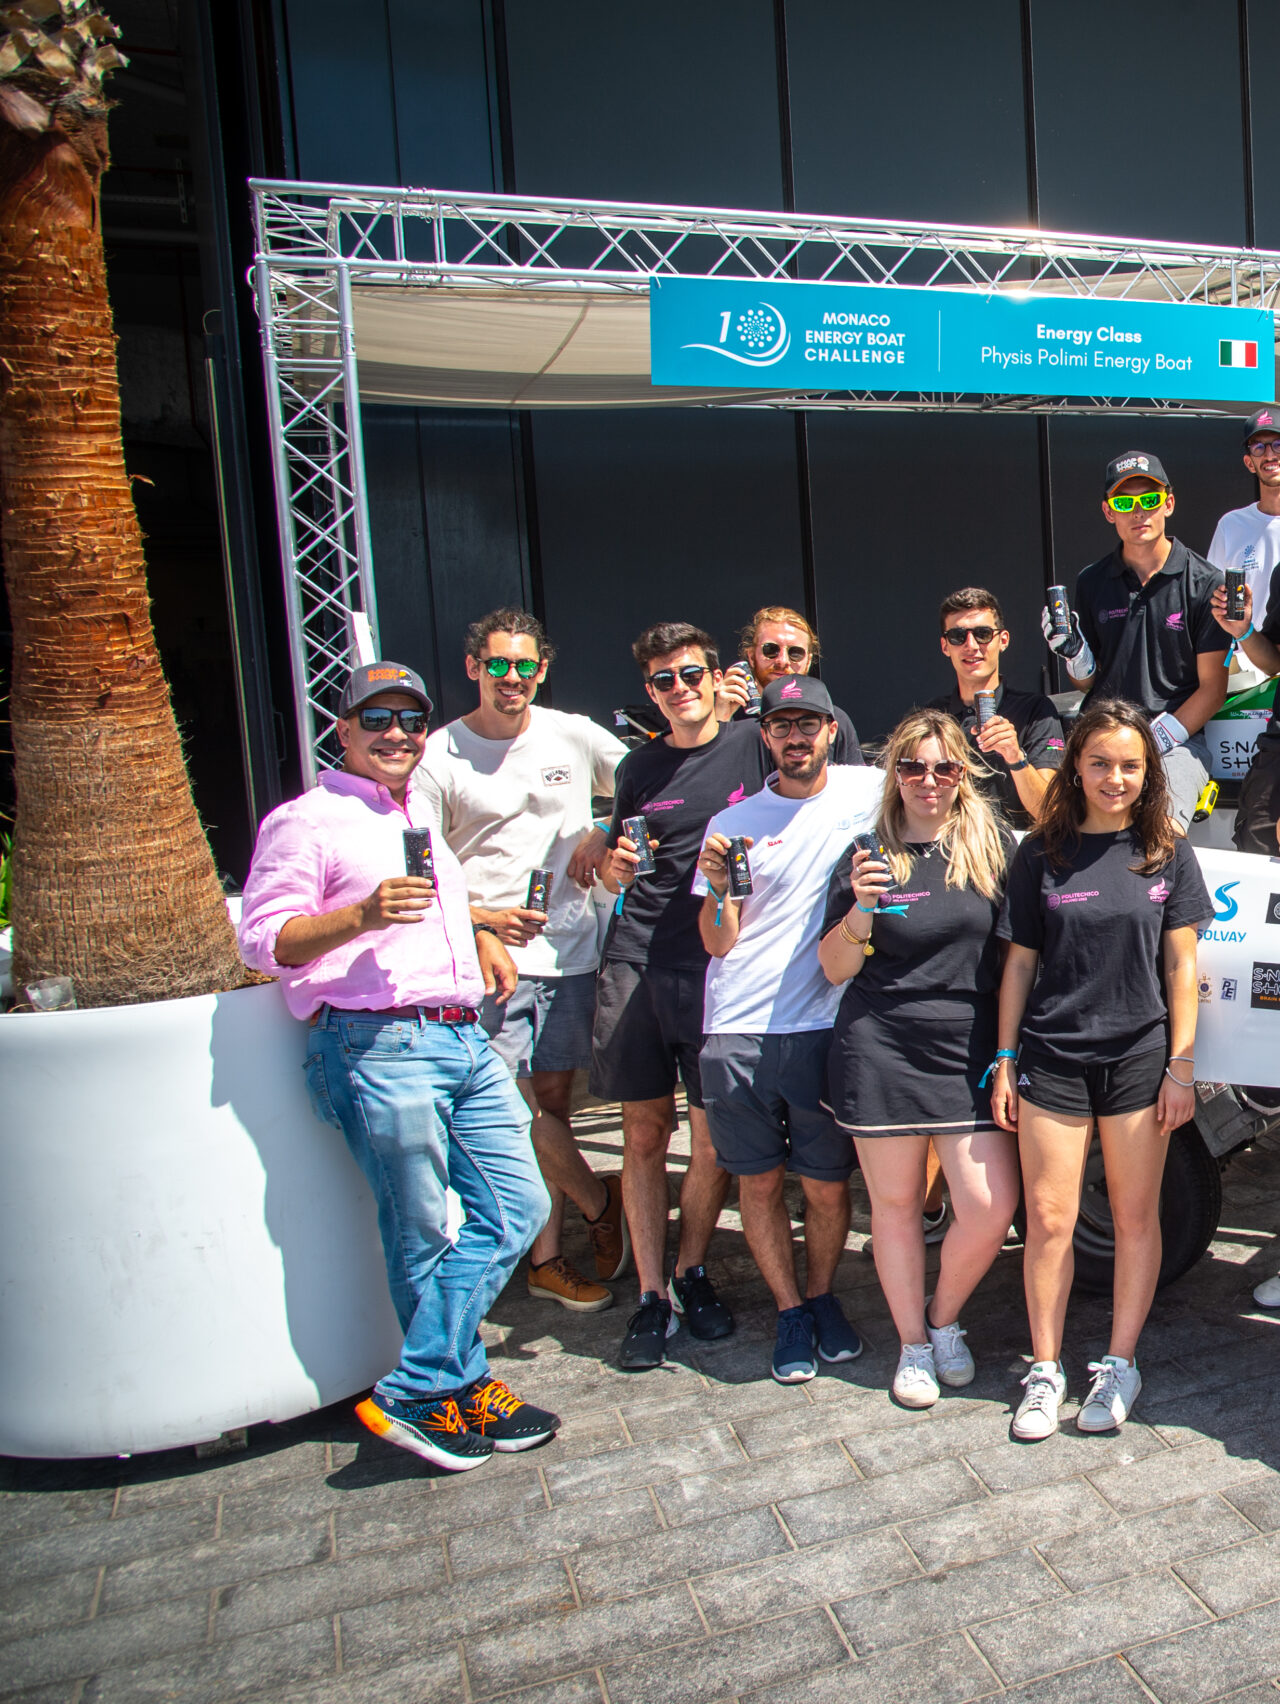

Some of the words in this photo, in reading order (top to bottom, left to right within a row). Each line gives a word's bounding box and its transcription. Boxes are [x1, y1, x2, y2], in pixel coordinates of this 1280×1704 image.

[822, 312, 891, 327] MONACO
[805, 330, 862, 345] ENERGY
[867, 332, 906, 347] BOAT
[1036, 324, 1093, 345] Energy
[1096, 326, 1143, 343] Class
[804, 348, 905, 364] CHALLENGE
[981, 346, 1033, 369] Physis
[1038, 348, 1088, 367] Polimi
[1094, 351, 1151, 374] Energy
[1155, 353, 1193, 371] Boat
[1061, 890, 1100, 900] POLITECNICO
[1197, 928, 1248, 943] SOLVAY
[1259, 995, 1278, 1003] BRAIN
